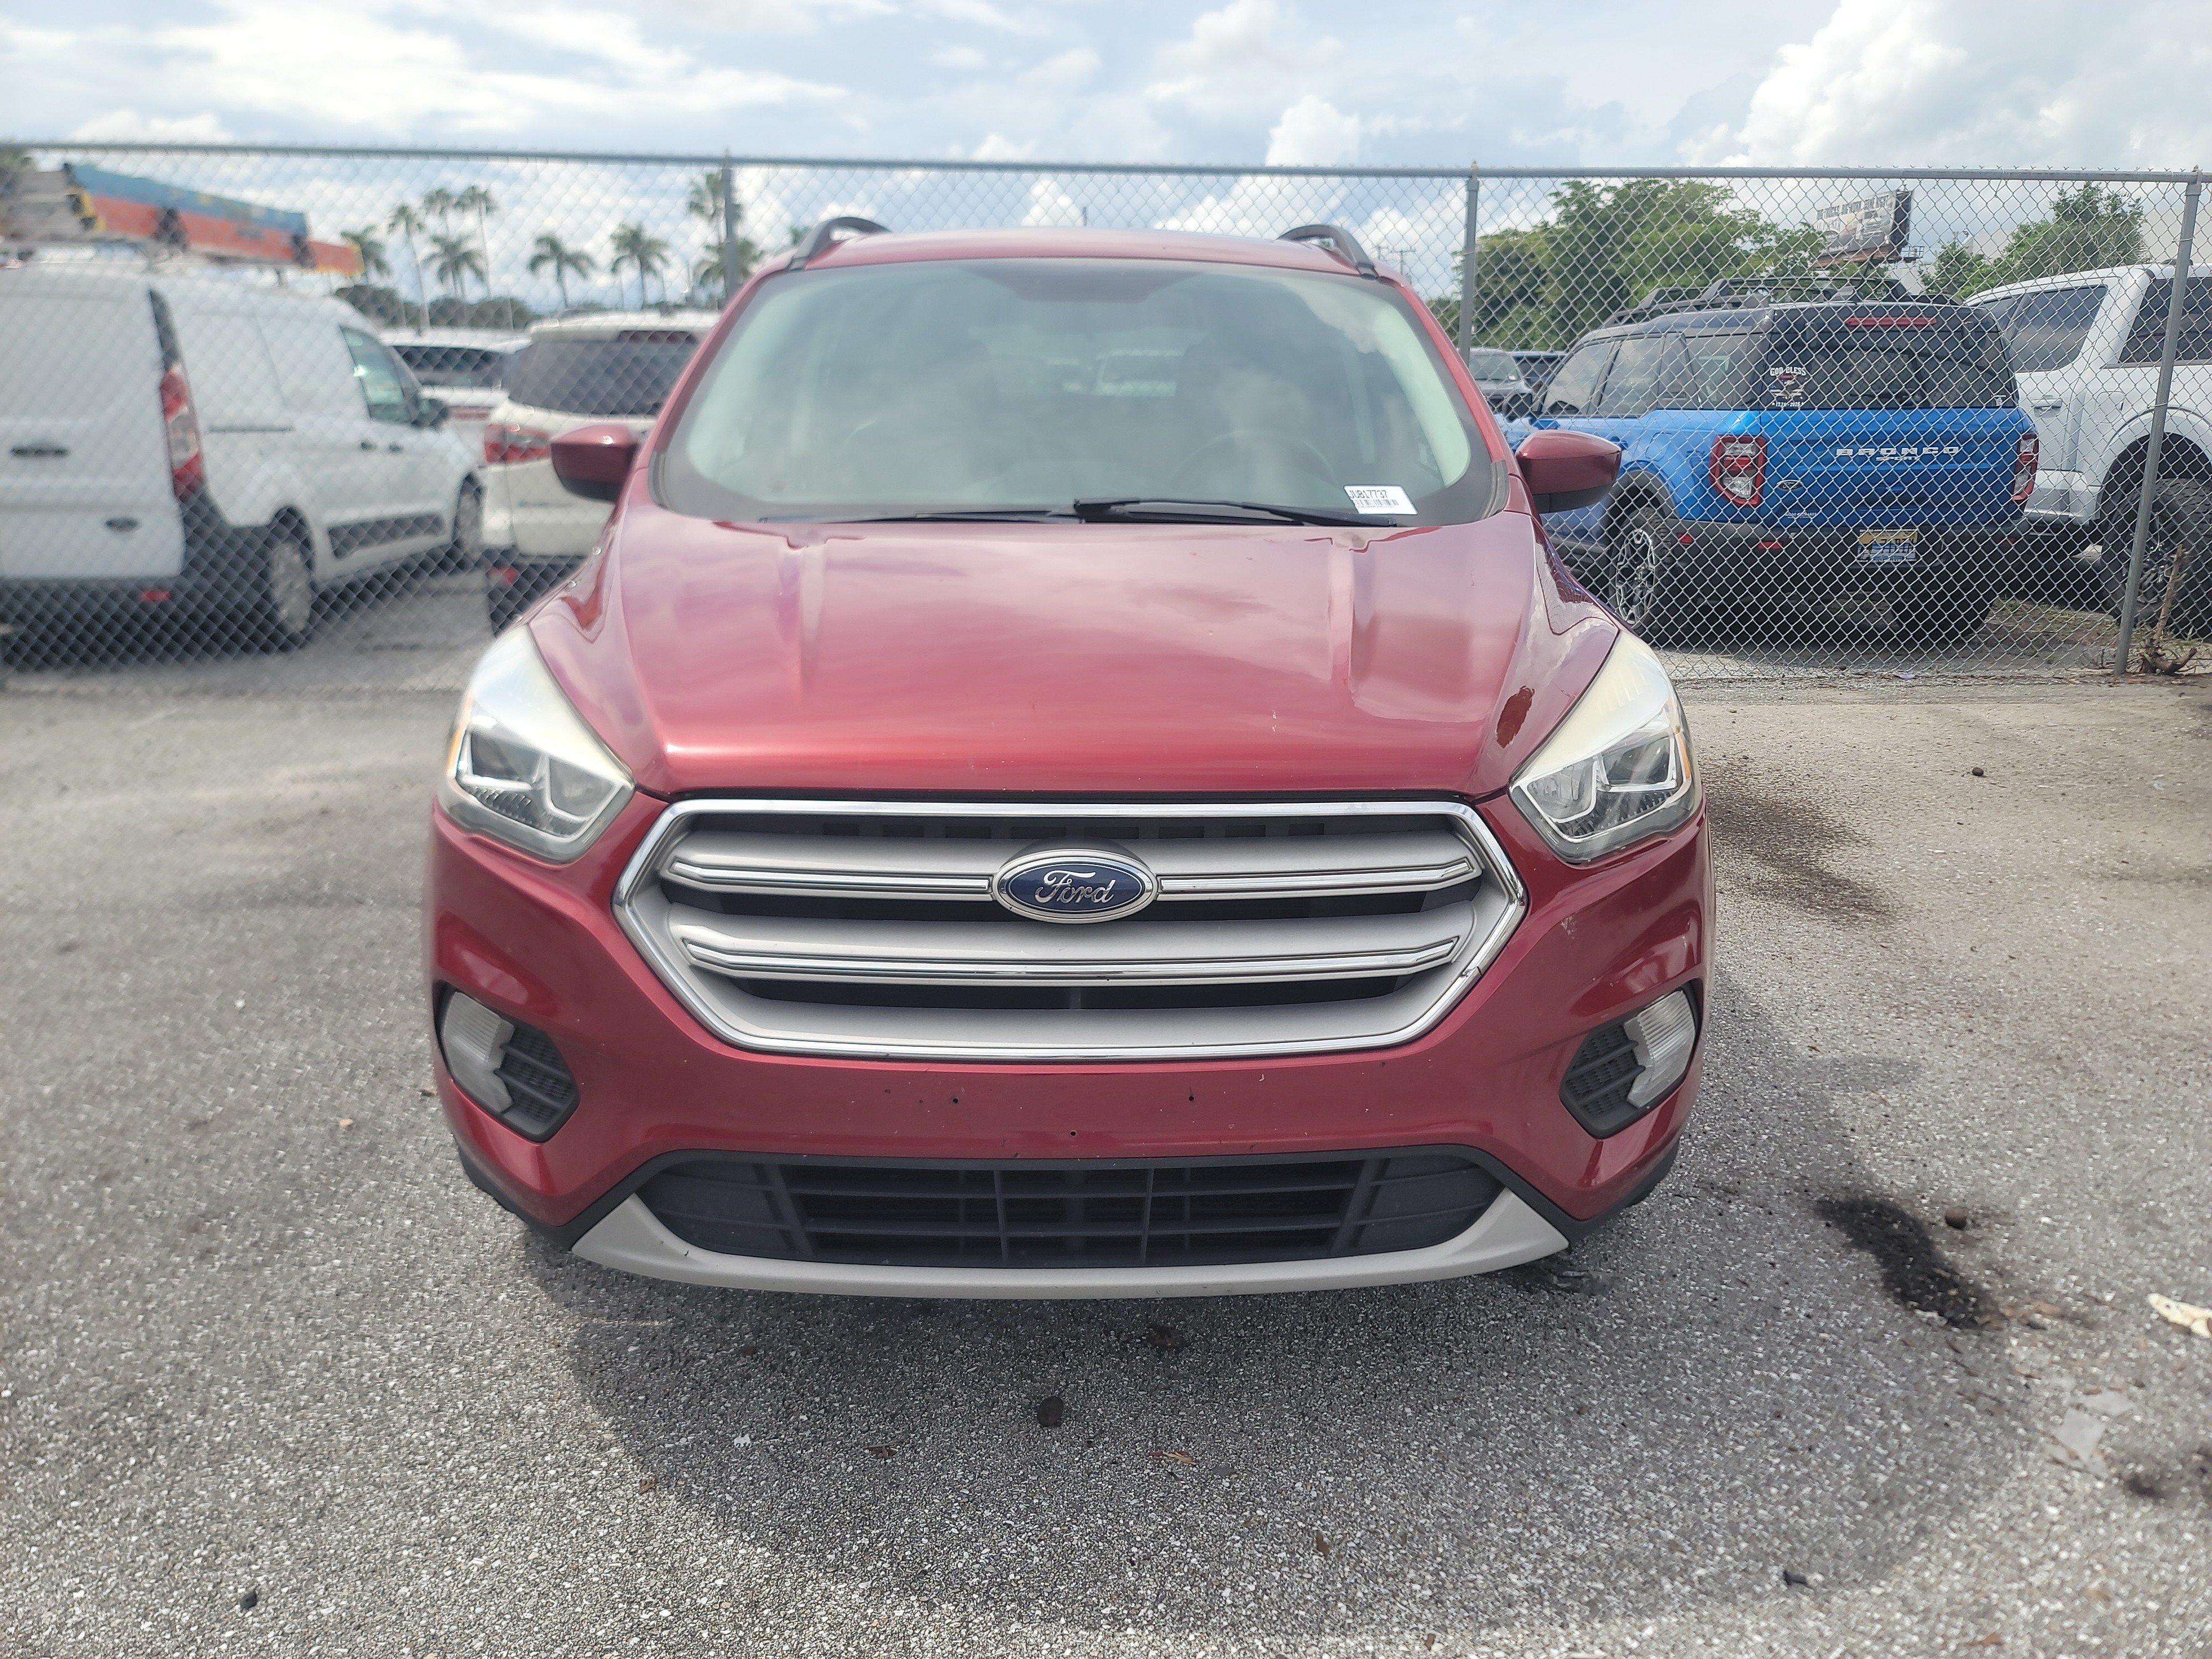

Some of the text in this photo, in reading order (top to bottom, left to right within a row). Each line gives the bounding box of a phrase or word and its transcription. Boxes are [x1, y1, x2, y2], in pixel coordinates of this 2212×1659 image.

[1770, 367, 1806, 376] GOD BLESS
[1836, 447, 1959, 456] BRONCO
[1349, 490, 1388, 498] JUB17737
[1035, 870, 1116, 903] Ford
